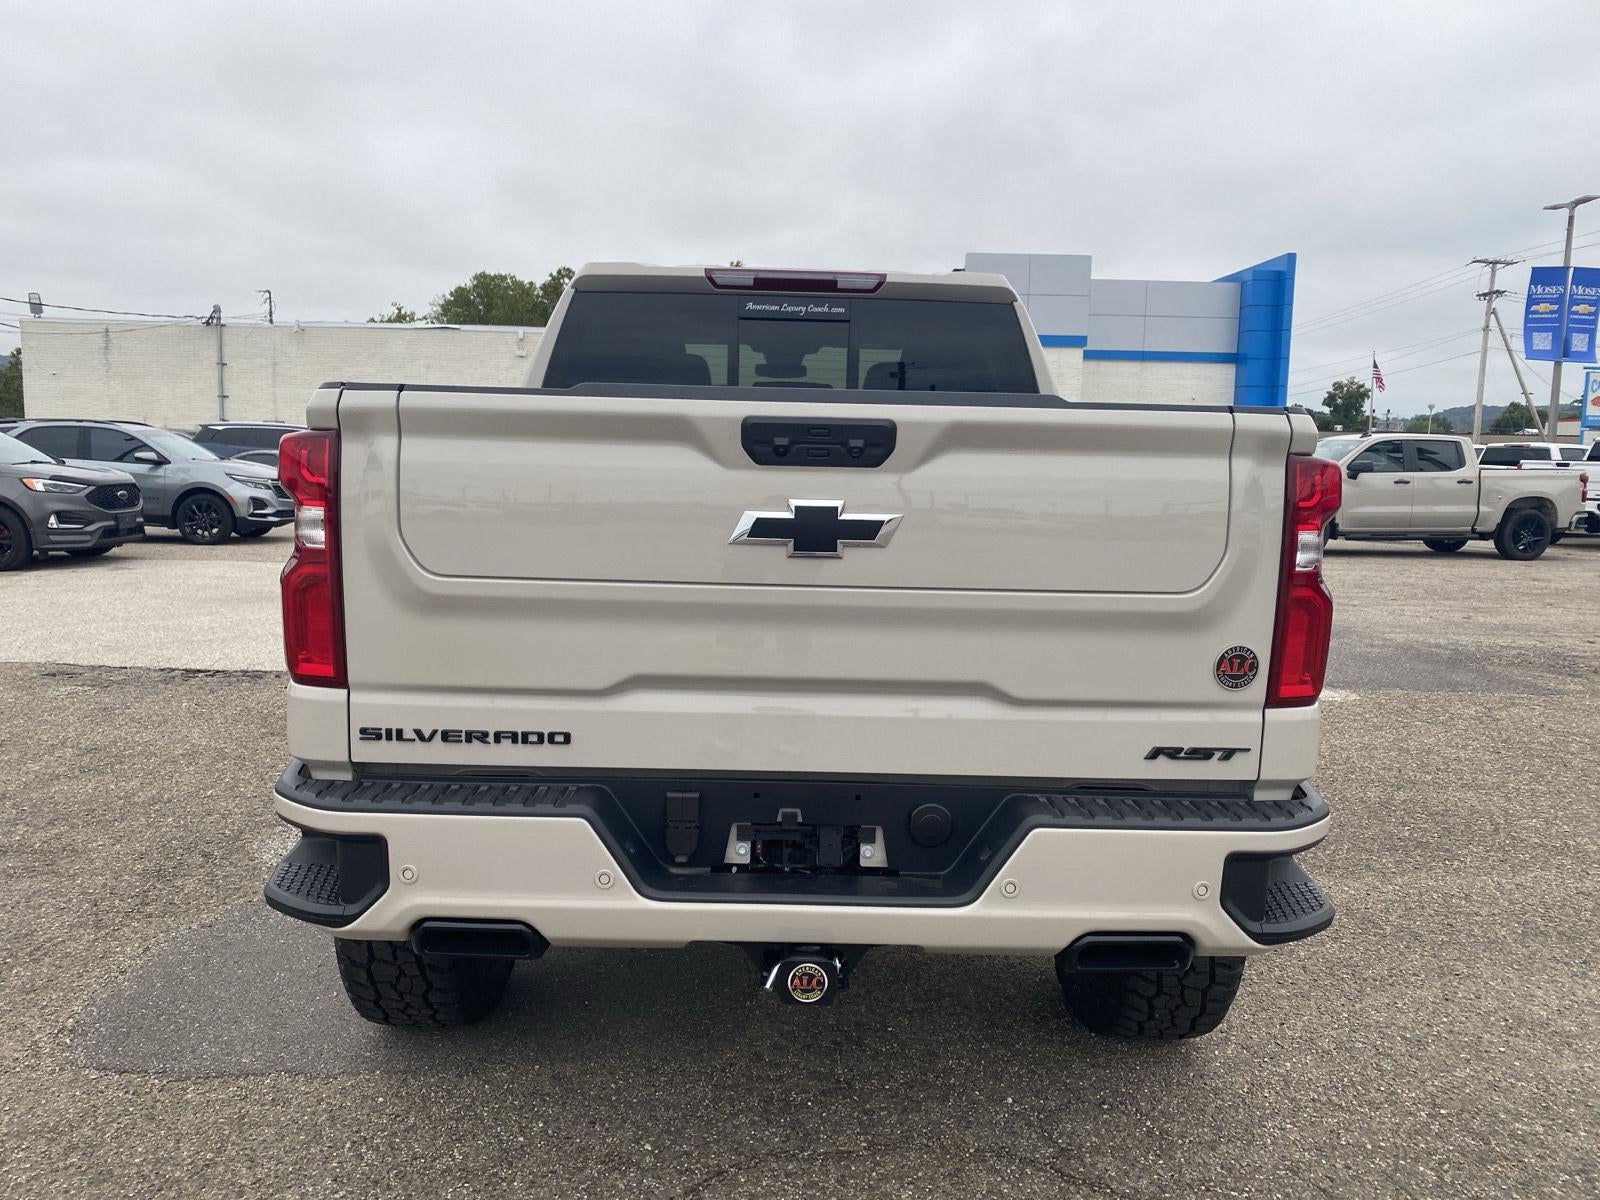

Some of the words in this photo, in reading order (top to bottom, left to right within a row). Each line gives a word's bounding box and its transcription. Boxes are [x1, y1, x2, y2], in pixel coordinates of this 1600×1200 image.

[1529, 284, 1565, 295] MOSES
[745, 302, 780, 311] American
[780, 303, 807, 316] Luxury
[807, 303, 846, 313] Coach.com
[1216, 658, 1257, 676] ALC
[359, 727, 572, 745] SILVERADO
[1143, 746, 1251, 761] RST
[791, 975, 824, 990] ALC
